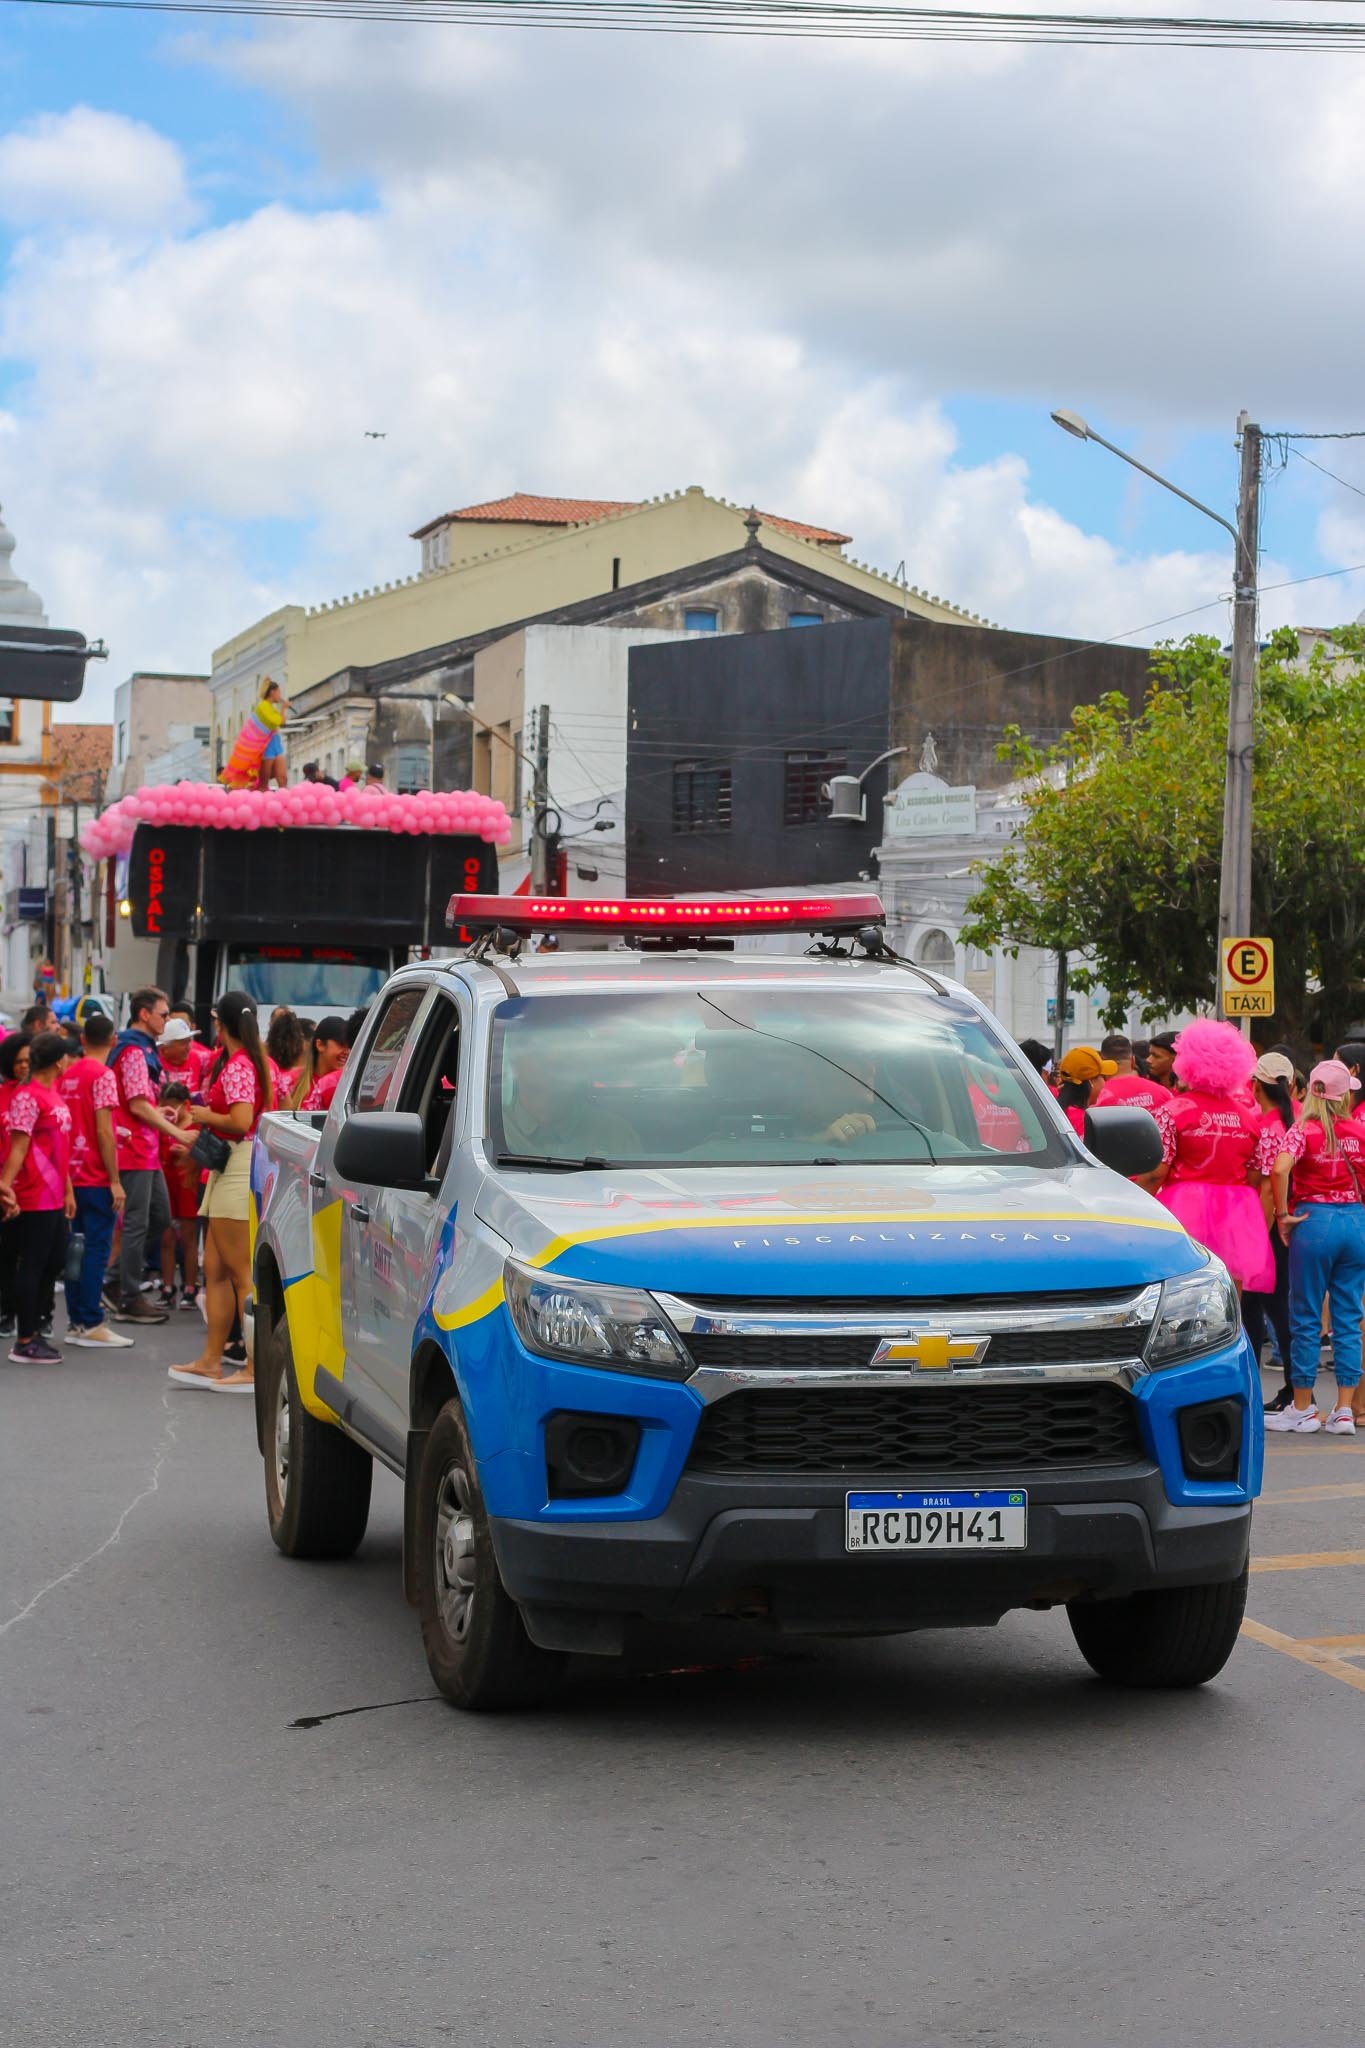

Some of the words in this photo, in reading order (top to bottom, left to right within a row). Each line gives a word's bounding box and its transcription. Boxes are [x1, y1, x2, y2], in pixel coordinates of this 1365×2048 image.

[147, 848, 165, 933] OSPAL
[459, 857, 481, 943] OSL
[1241, 950, 1256, 975] E
[1230, 994, 1266, 1010] TÁXI
[1212, 1112, 1240, 1121] AMPARO
[733, 1232, 1072, 1249] FISCALIZAÇÃO
[923, 1498, 951, 1506] BRASIL
[862, 1511, 1005, 1544] RCD9H41
[850, 1537, 860, 1548] BR
